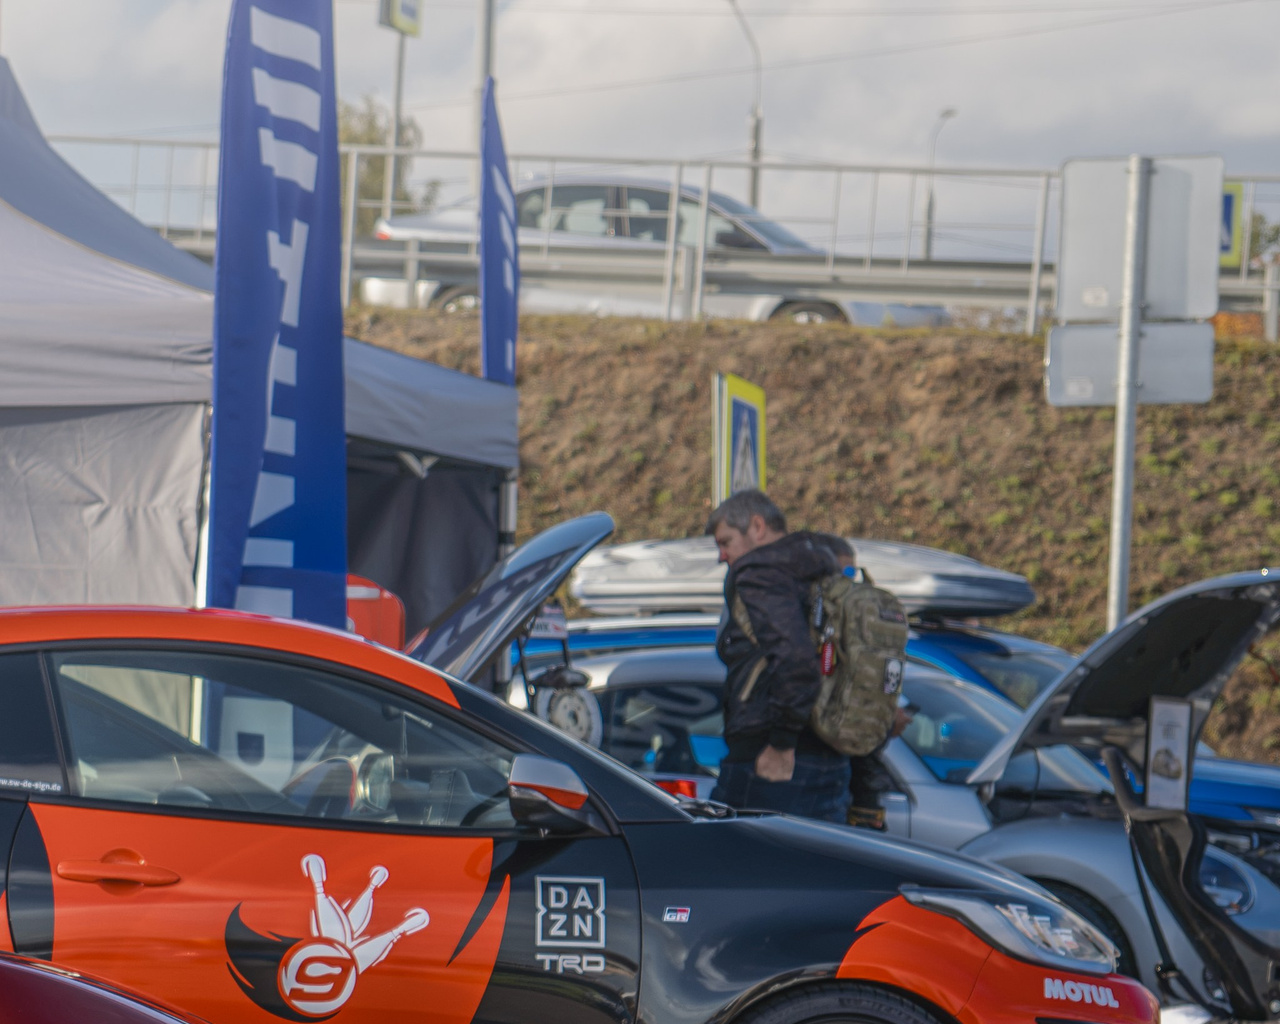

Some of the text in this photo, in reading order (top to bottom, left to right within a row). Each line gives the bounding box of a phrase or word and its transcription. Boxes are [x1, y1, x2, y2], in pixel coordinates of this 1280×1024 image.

[665, 911, 689, 921] GR
[535, 953, 606, 975] TRD
[1044, 978, 1120, 1009] MOTUL
